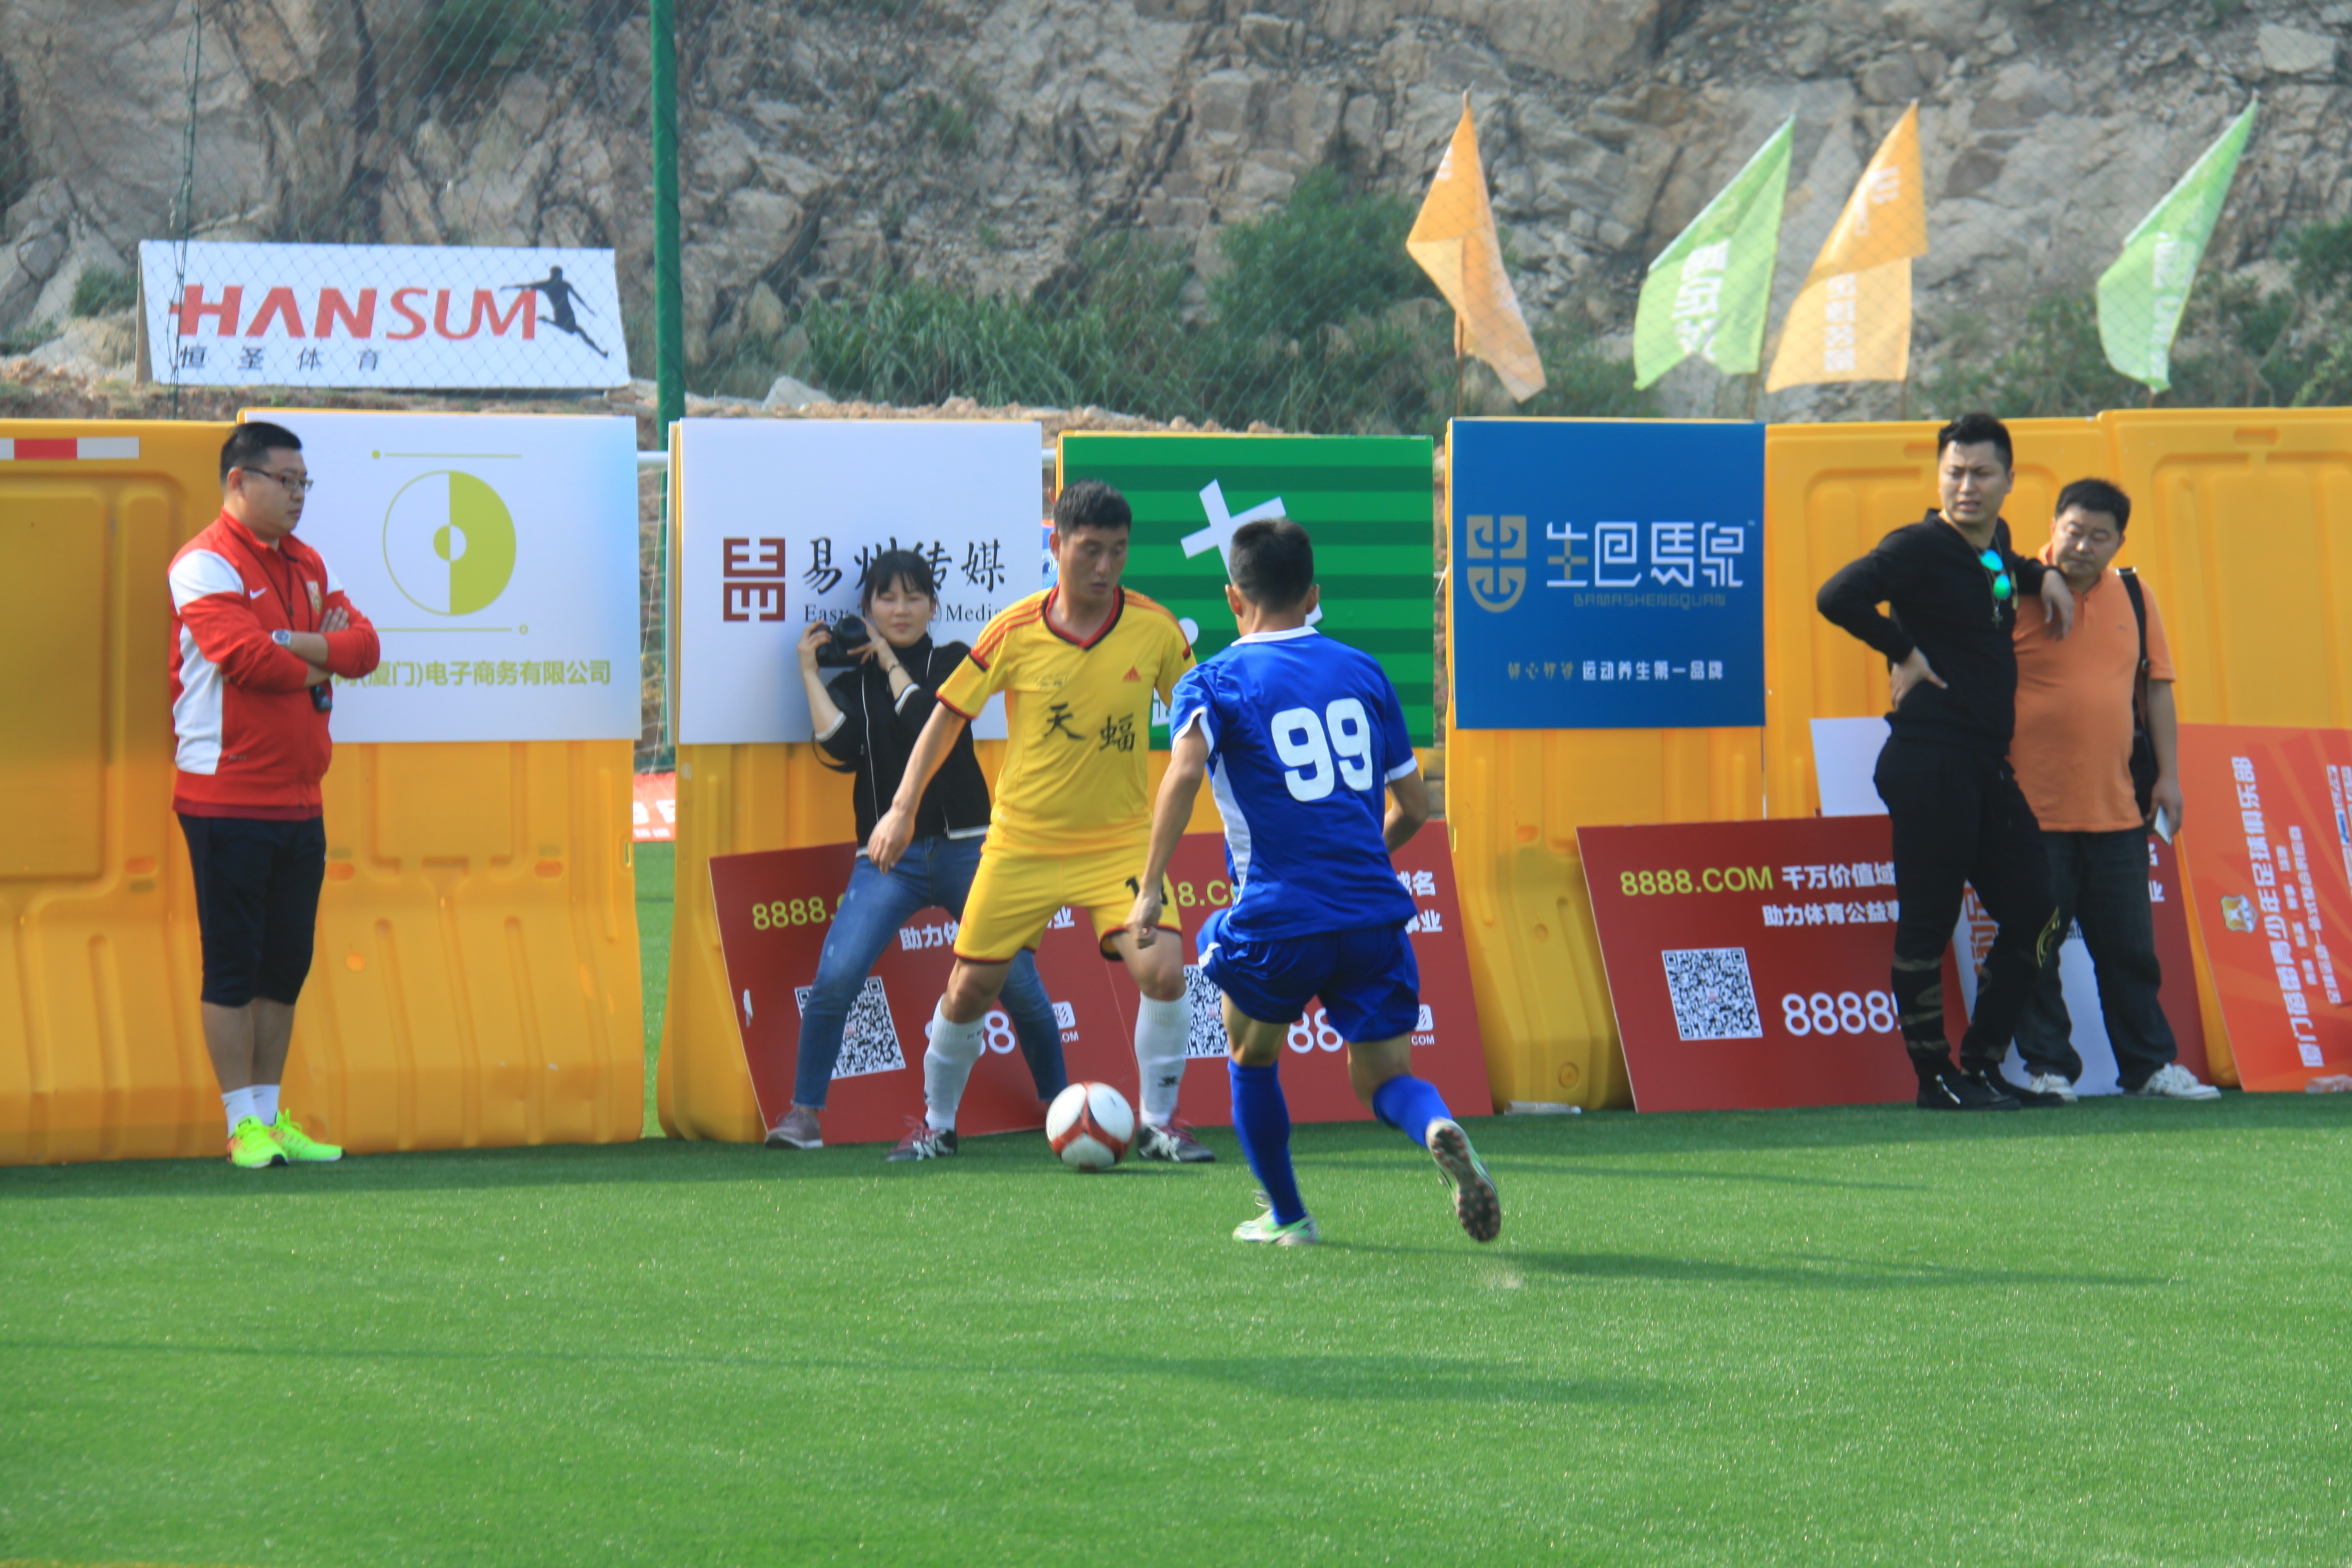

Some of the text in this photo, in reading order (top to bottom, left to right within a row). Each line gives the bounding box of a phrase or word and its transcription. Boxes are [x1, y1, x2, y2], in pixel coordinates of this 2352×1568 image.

[168, 285, 537, 341] HANSUM
[180, 345, 382, 371] 恒圣体育
[1573, 592, 1726, 610] BAMASHENGQUAN
[1582, 660, 1723, 681] 运动养生第一品牌
[1271, 697, 1373, 801] 99
[1620, 866, 1774, 896] 8888.COM
[1781, 990, 1900, 1036] 8888
